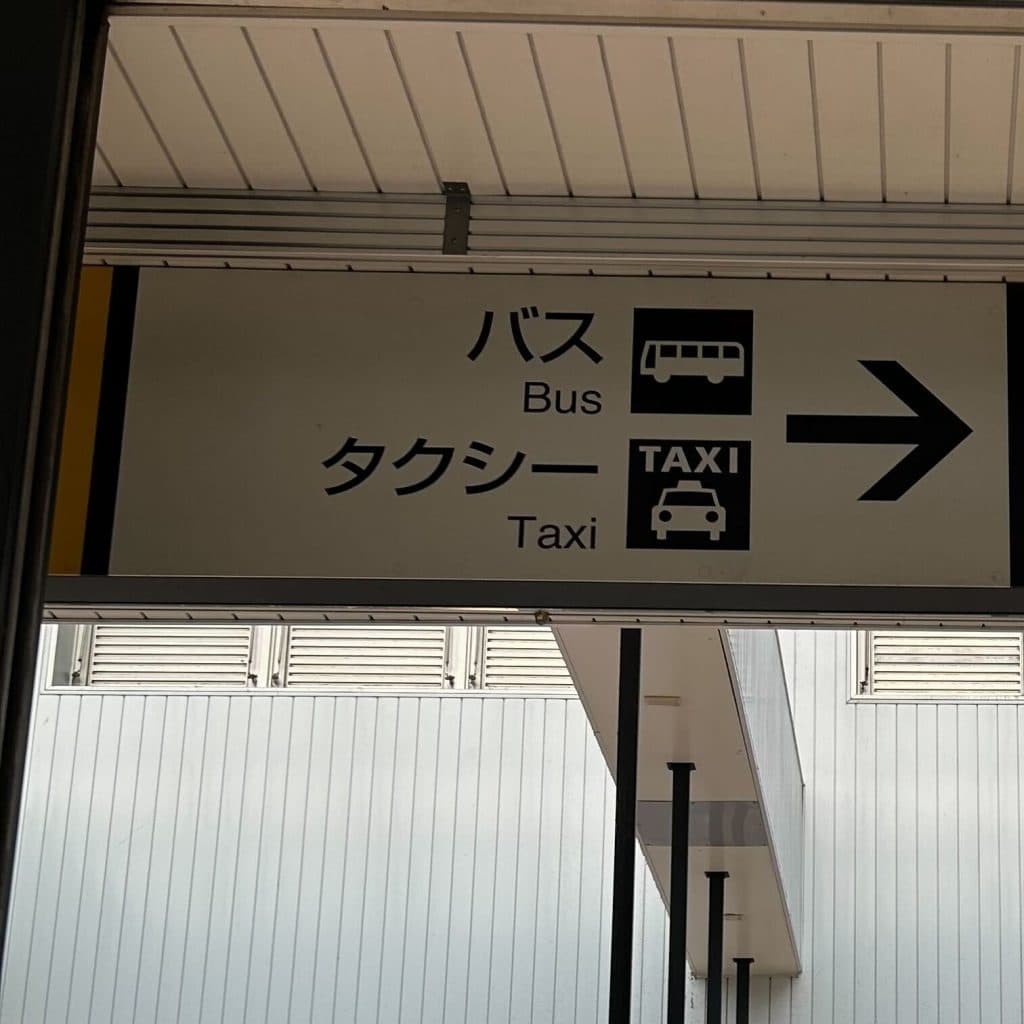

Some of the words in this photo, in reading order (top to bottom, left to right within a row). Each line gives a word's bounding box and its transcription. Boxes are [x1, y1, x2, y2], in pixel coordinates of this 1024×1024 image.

[467, 308, 603, 363] バス
[522, 382, 602, 415] Bus
[321, 436, 600, 496] タクシー
[638, 444, 741, 474] TAXI
[507, 513, 598, 550] Taxi
